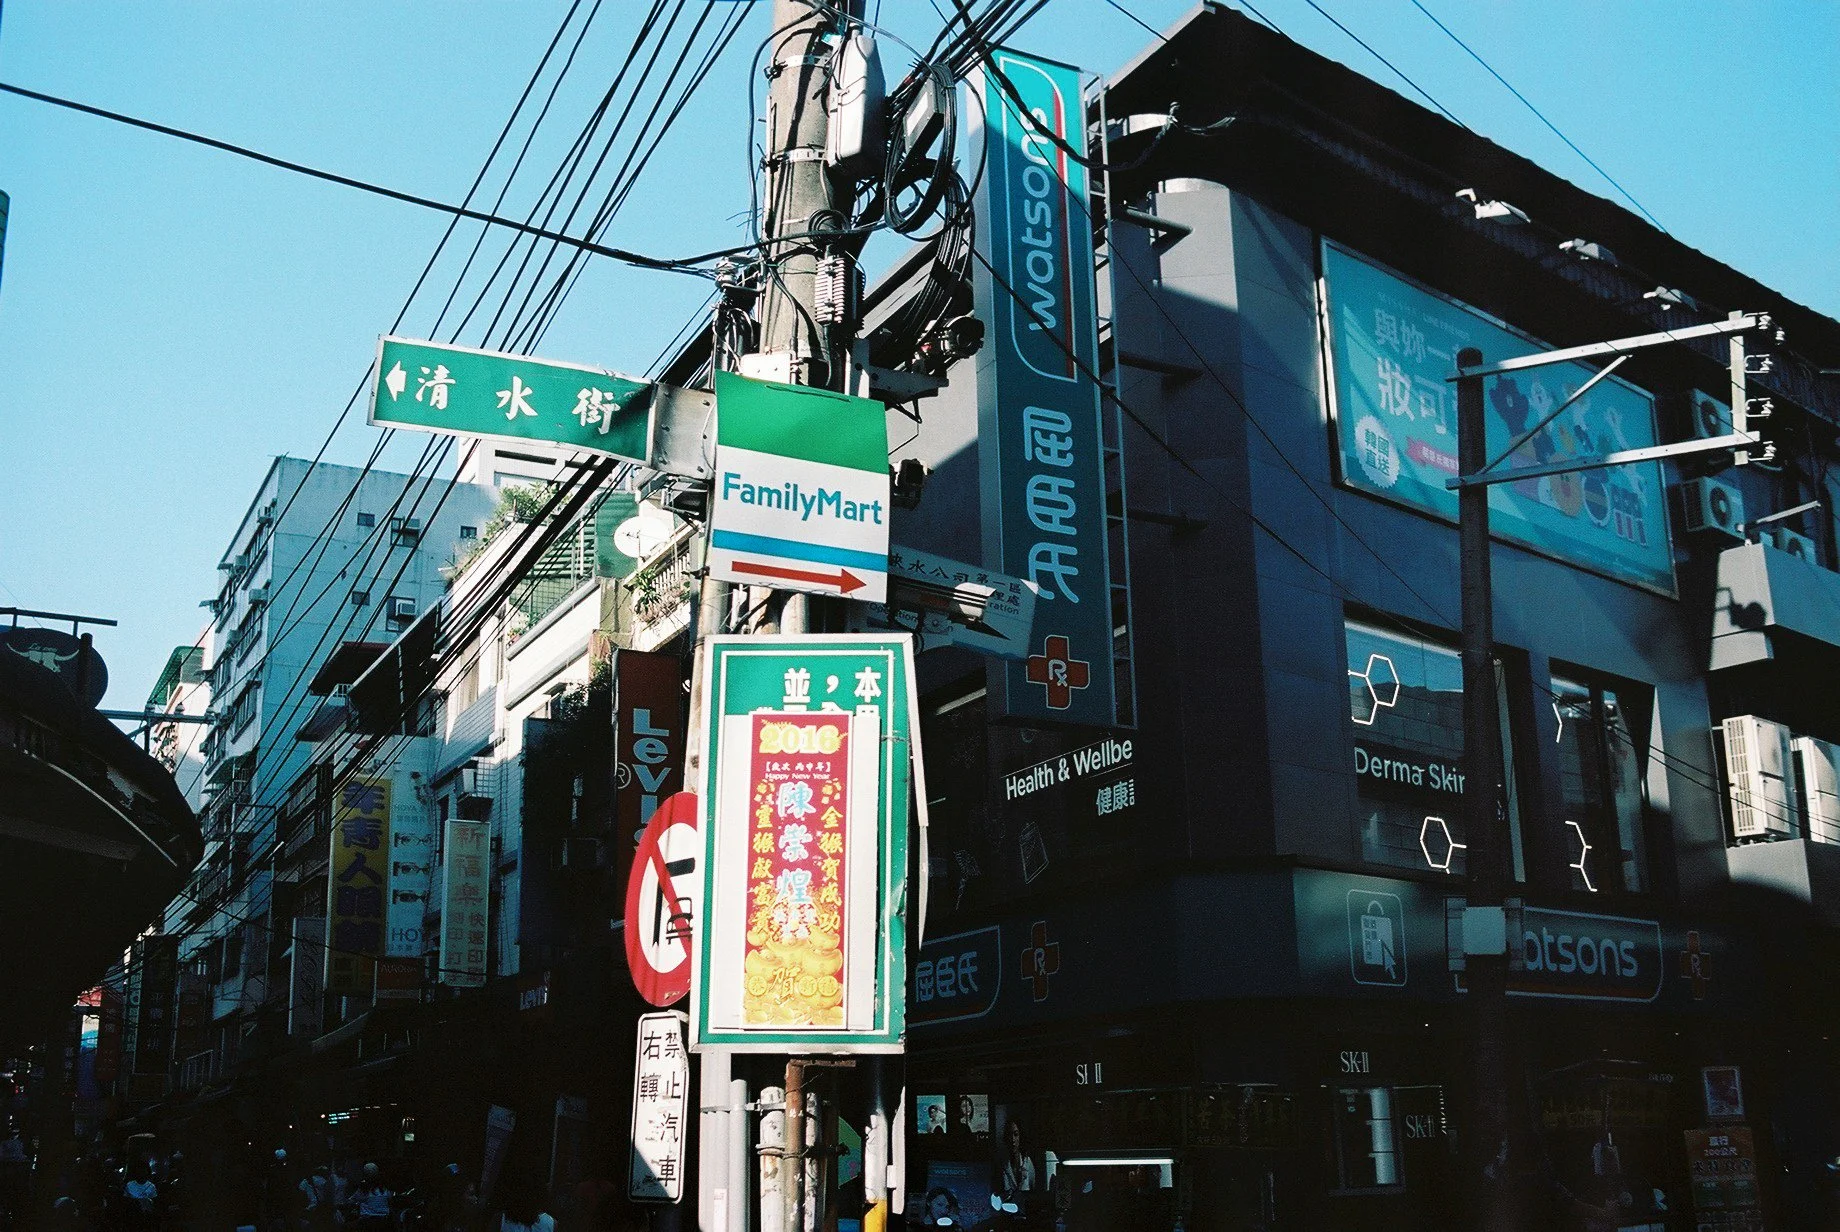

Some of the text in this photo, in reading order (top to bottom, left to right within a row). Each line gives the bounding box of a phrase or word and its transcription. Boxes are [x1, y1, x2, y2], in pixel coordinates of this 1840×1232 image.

[1020, 106, 1057, 333] watsons
[1375, 309, 1458, 366] 與妳一
[415, 364, 620, 435] 清水街
[1377, 356, 1457, 434] 妝可
[722, 471, 882, 525] FamilyMart
[1023, 405, 1080, 604] 屈臣氏
[759, 724, 841, 755] 2016
[1006, 739, 1133, 800] Health & Wellbe
[1354, 747, 1422, 786] Derma
[915, 950, 979, 1003] 屈臣氏
[1523, 926, 1639, 978] atsons
[640, 1030, 662, 1103] 右轉
[657, 1030, 682, 1188] 禁止汽車
